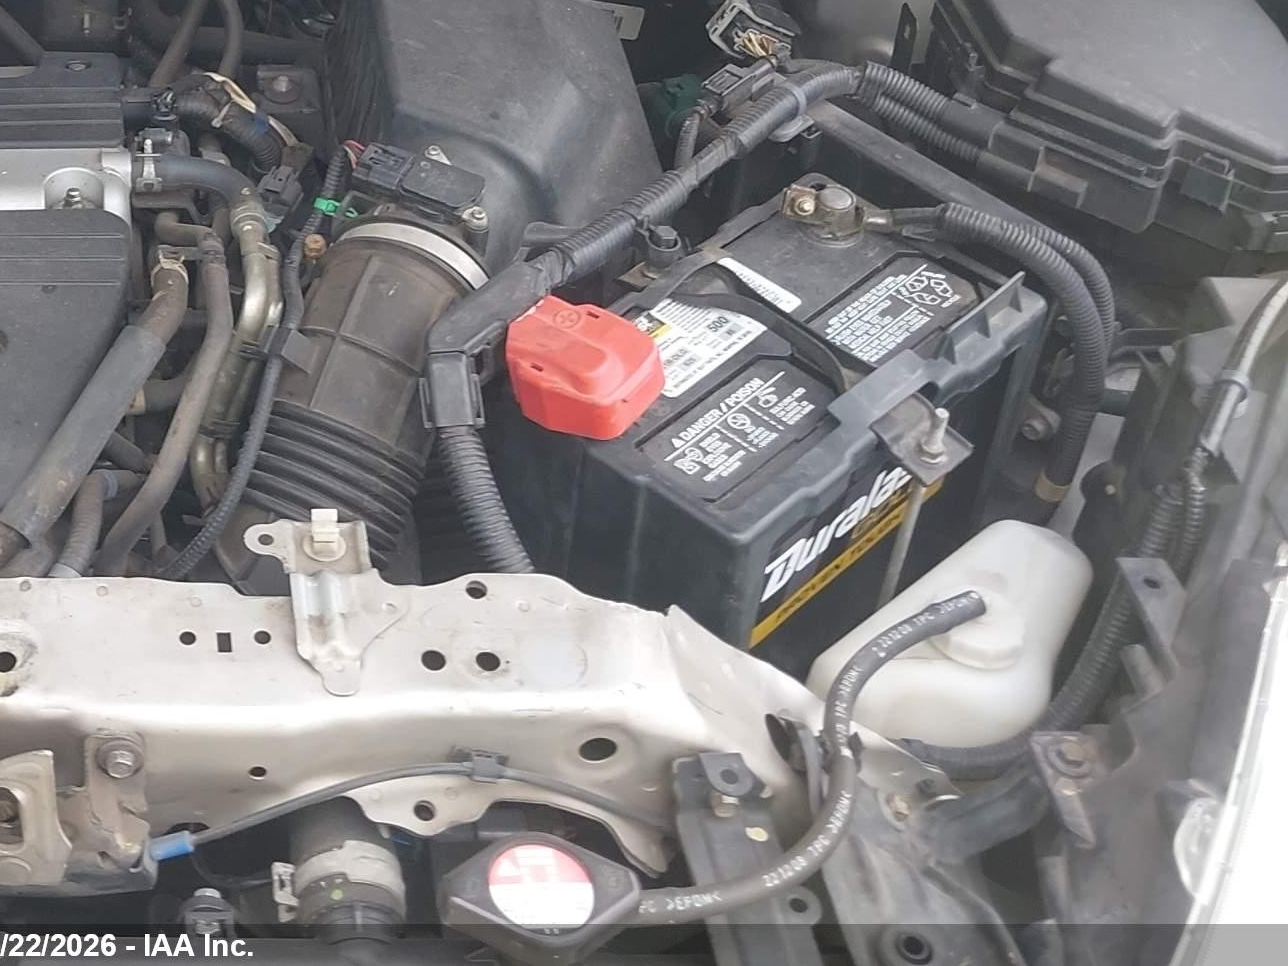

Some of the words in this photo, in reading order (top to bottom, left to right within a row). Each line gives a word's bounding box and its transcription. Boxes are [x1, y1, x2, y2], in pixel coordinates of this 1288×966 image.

[705, 316, 730, 333] 500
[679, 408, 720, 441] DANGER
[725, 377, 764, 408] POISON
[760, 466, 913, 603] Duralas
